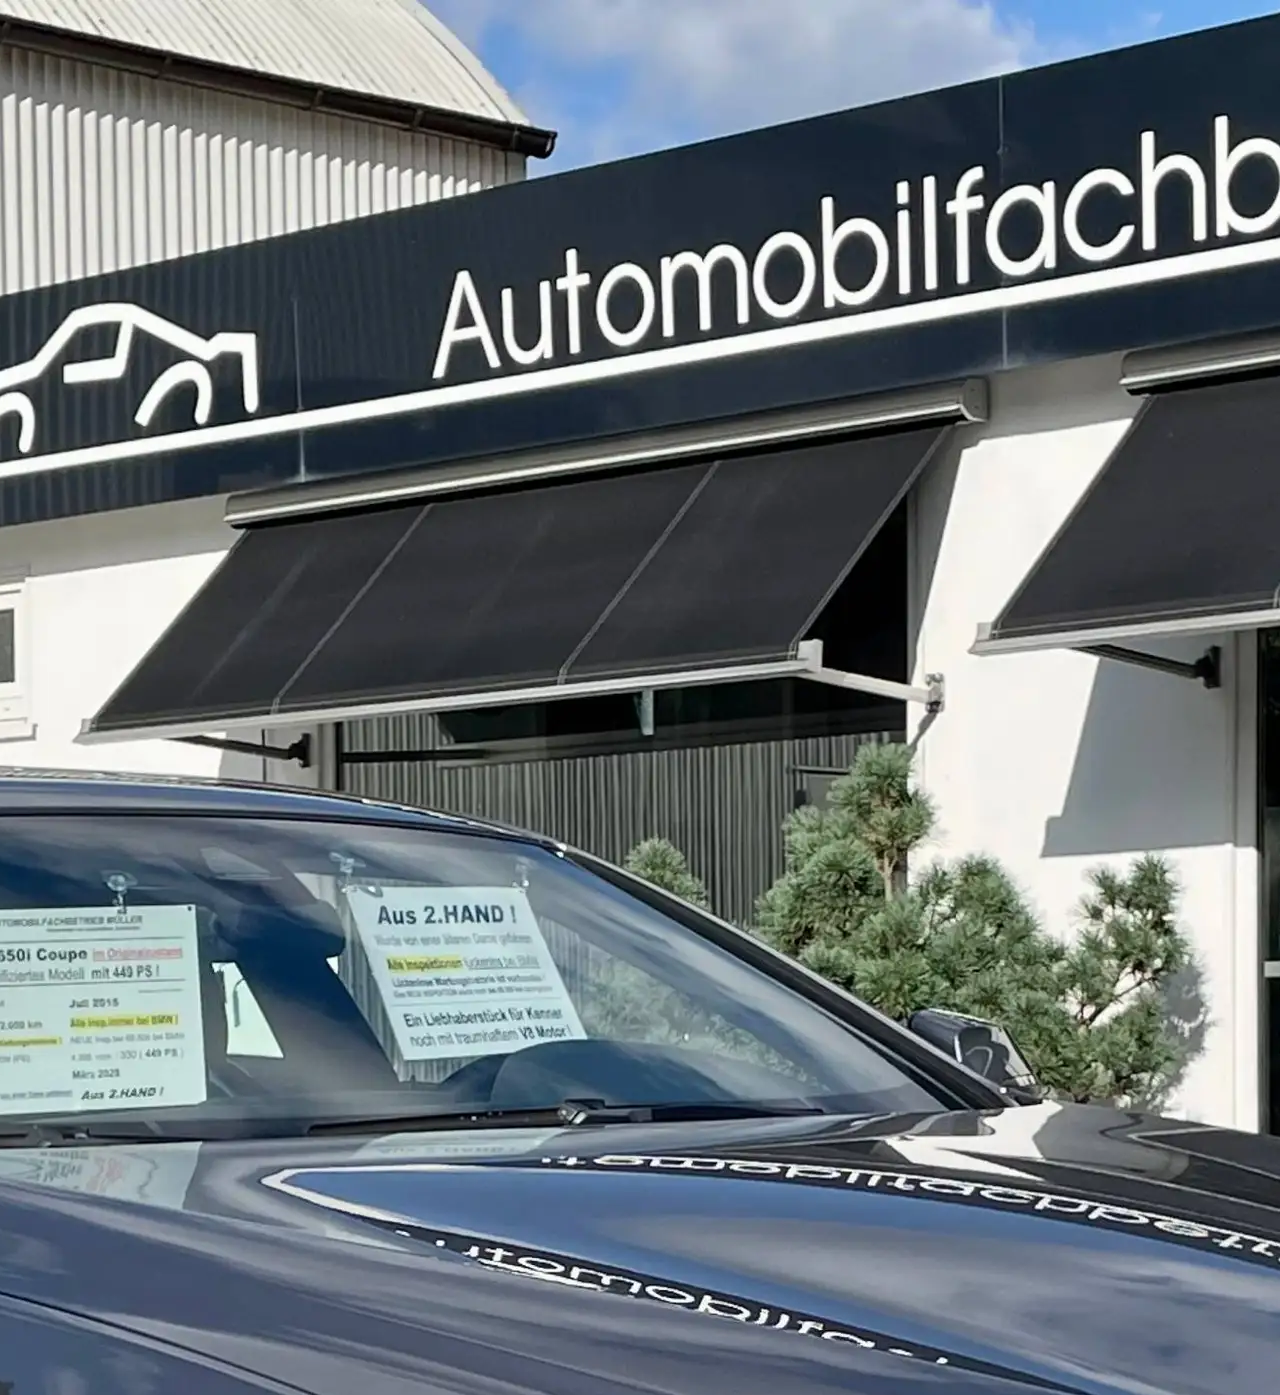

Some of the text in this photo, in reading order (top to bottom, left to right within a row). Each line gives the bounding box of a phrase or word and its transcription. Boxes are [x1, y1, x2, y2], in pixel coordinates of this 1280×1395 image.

[377, 905, 417, 925] Aus
[423, 904, 504, 924] 2.HAND
[36, 948, 88, 965] Coupe
[48, 965, 85, 981] Modell
[91, 964, 111, 979] mit
[112, 965, 133, 978] 449
[136, 964, 153, 977] PS
[69, 998, 90, 1009] Juli
[27, 1019, 43, 1029] km
[403, 1006, 563, 1027] Ein Liebhaberstück für Kenner
[520, 1027, 536, 1040] V8
[81, 1088, 105, 1100] Aus
[108, 1086, 157, 1099] 2.HAND
